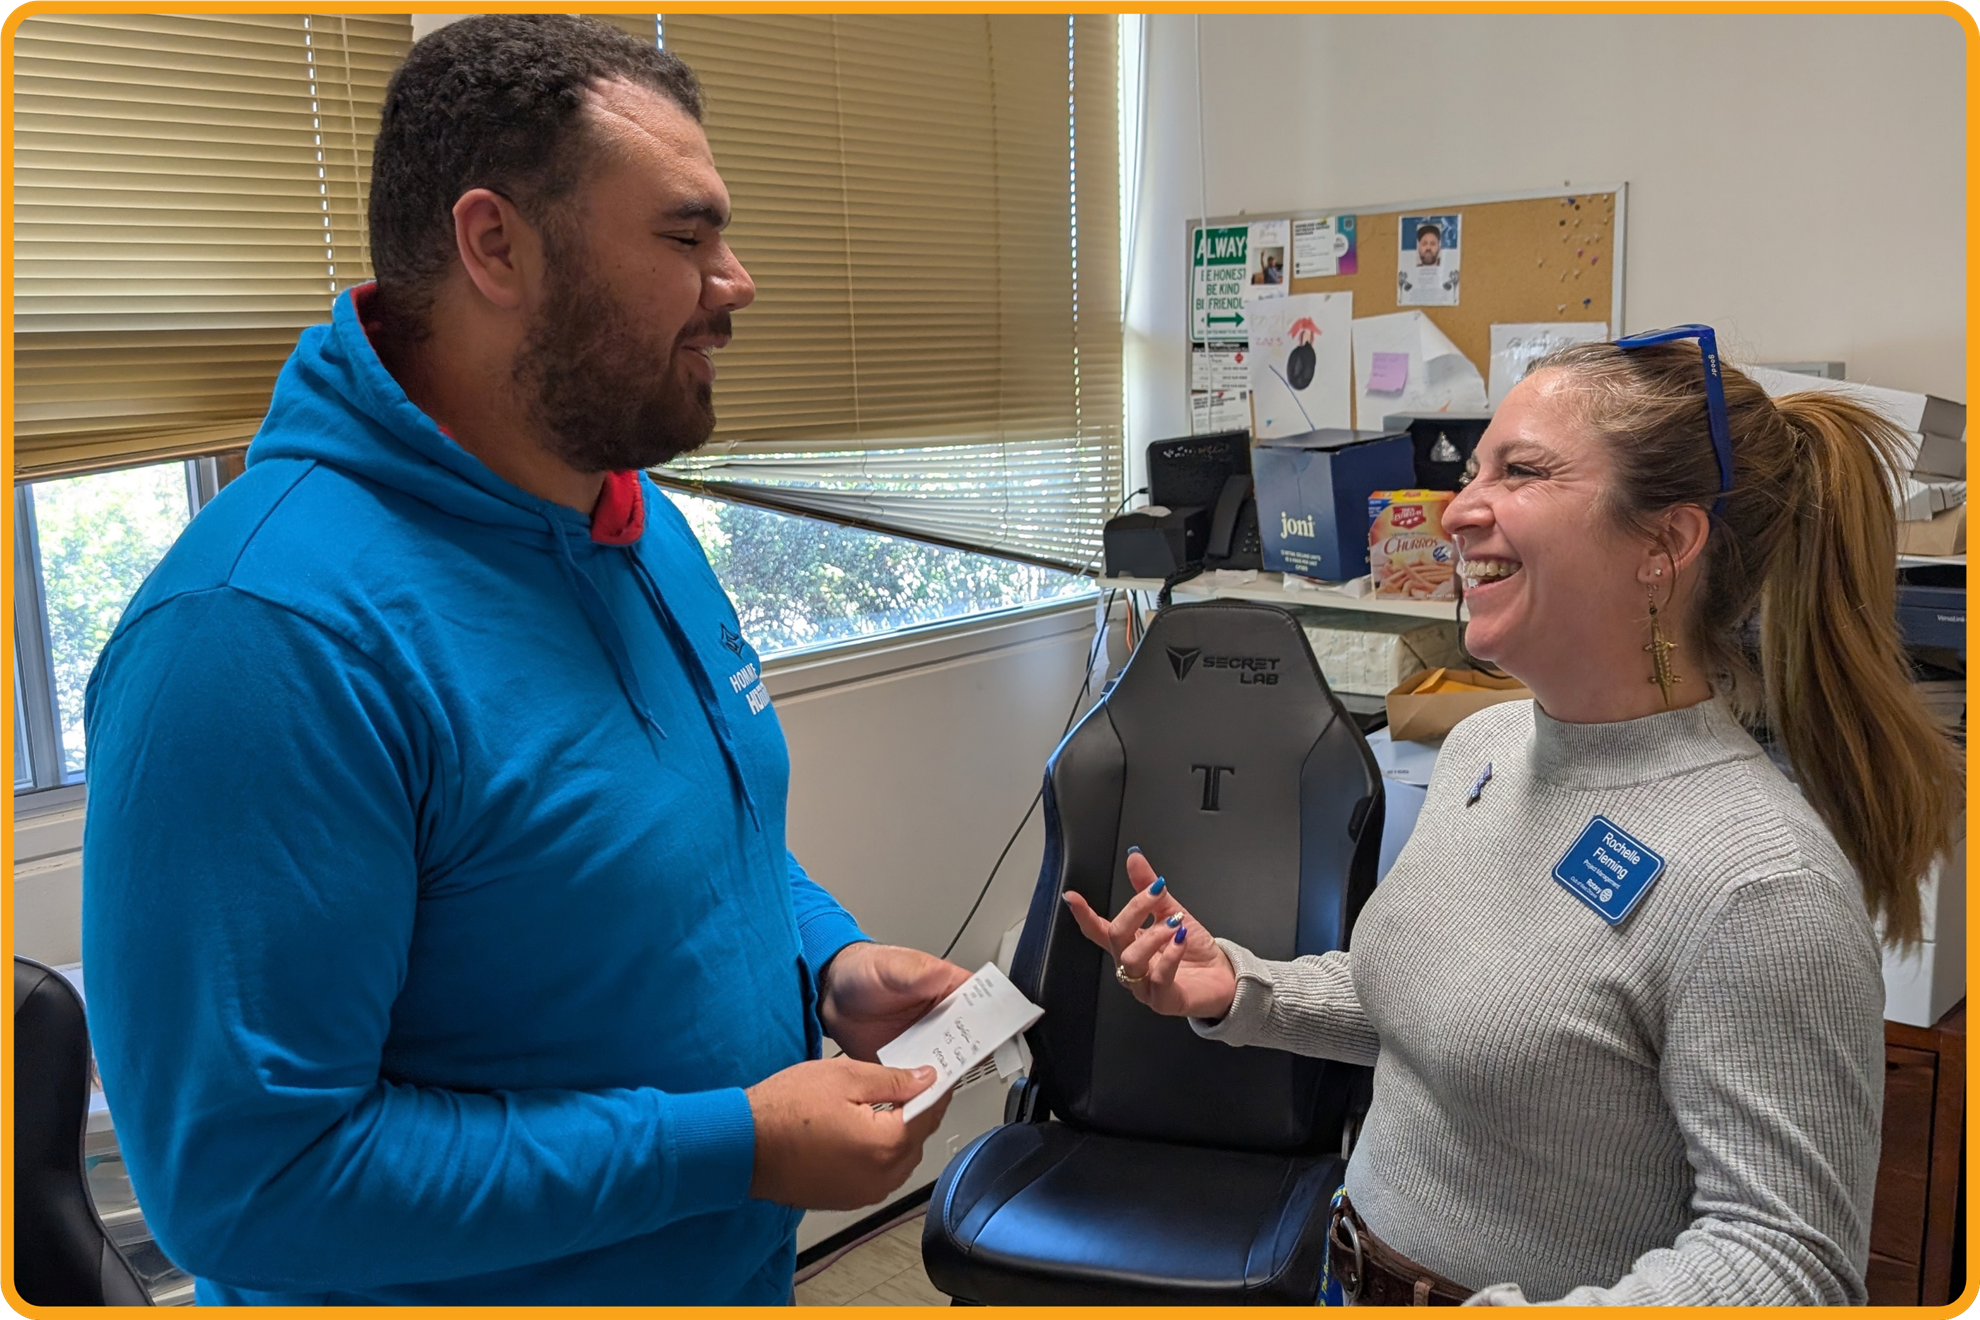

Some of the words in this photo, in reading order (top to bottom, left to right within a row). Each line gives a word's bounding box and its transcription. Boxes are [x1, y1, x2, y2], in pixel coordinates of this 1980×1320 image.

[1196, 235, 1248, 260] ALWAY
[1213, 267, 1247, 281] HONEST
[1206, 284, 1218, 296] BE
[1219, 283, 1240, 296] KIND
[1208, 298, 1245, 310] FRIENDL
[1708, 354, 1718, 377] goodr
[1280, 511, 1315, 539] joni
[1202, 656, 1281, 672] SECRET
[1239, 672, 1279, 686] LAB
[1602, 831, 1641, 866] Rochelle
[1592, 846, 1629, 880] Fleming
[1582, 858, 1598, 873] Project
[1595, 868, 1621, 890] Management
[1585, 878, 1602, 895] Rotary
